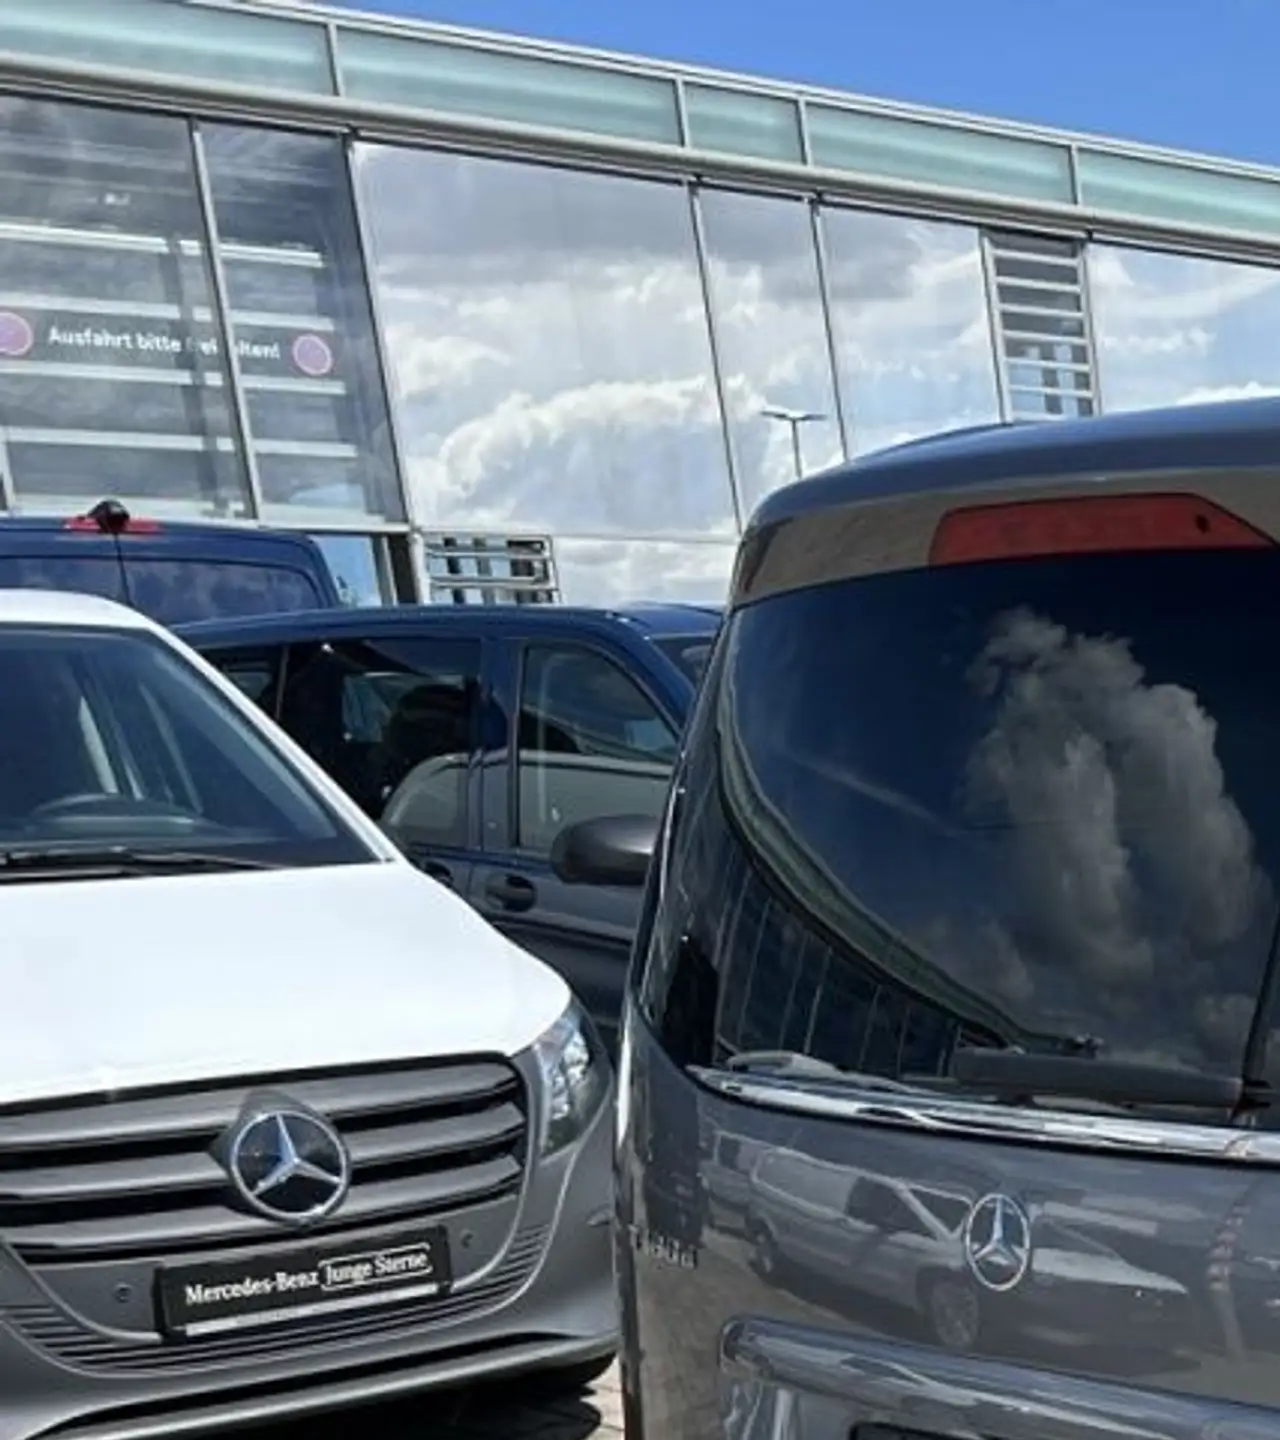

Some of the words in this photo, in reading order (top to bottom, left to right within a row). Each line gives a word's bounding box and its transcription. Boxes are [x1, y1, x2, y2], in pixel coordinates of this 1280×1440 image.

[49, 326, 133, 350] Ausfahrt
[135, 334, 182, 353] bitte
[186, 336, 281, 360] eilten!
[184, 1269, 319, 1306] Mercedes-Benz
[326, 1261, 373, 1286] Junge
[374, 1251, 429, 1276] Sterne
